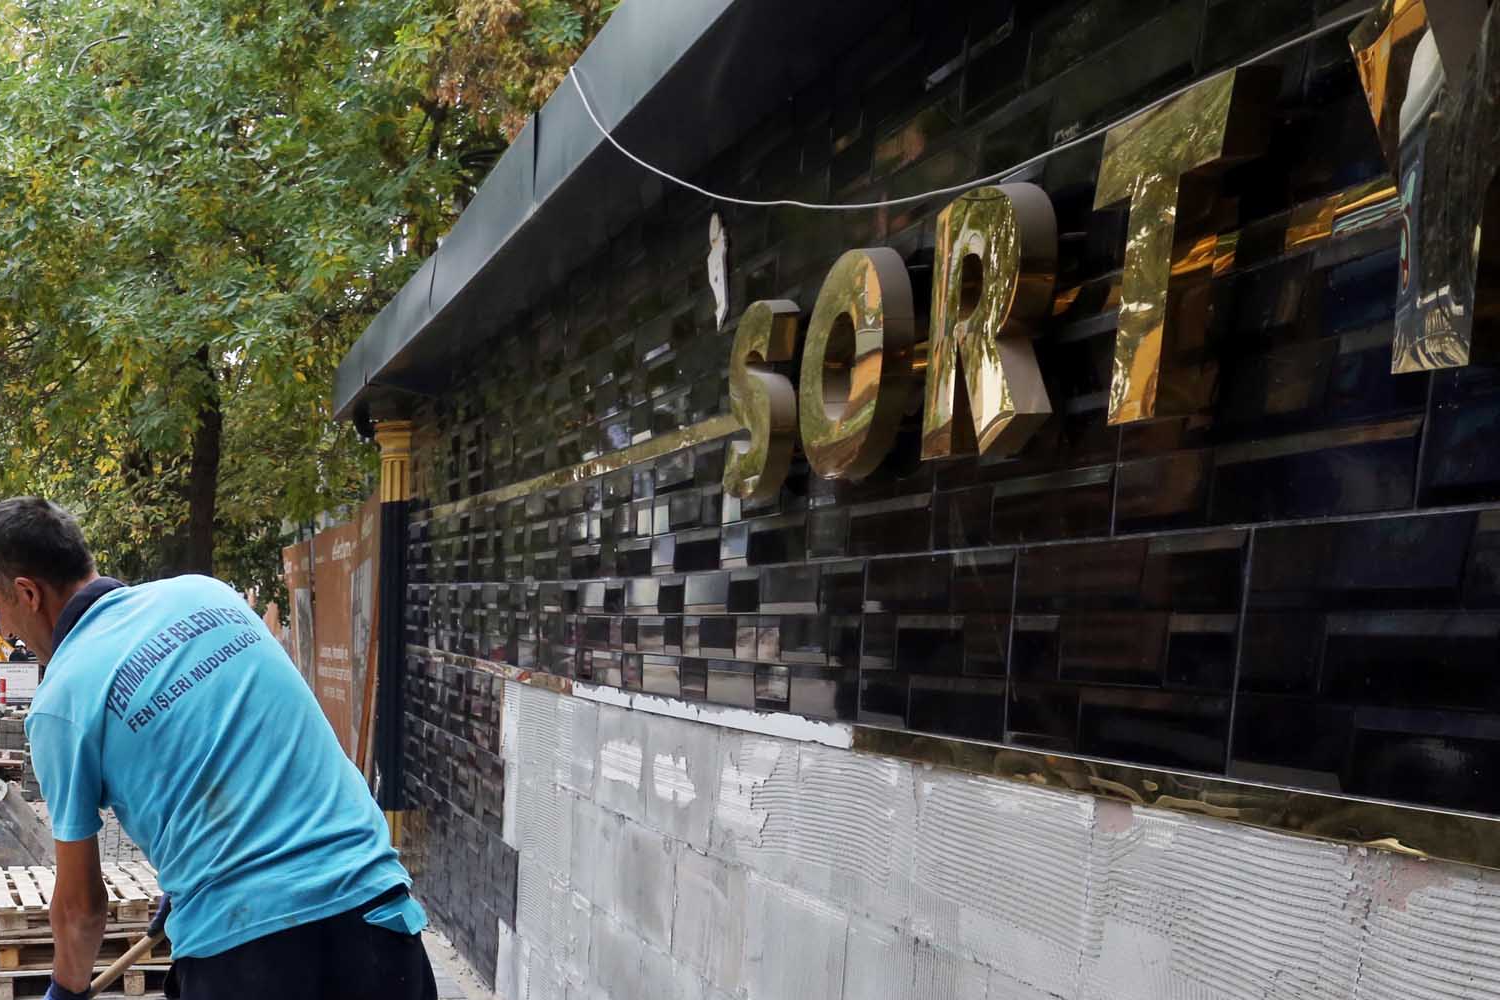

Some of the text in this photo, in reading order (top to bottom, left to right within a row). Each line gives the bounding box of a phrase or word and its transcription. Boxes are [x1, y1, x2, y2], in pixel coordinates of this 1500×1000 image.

[106, 605, 255, 721] YENİMAHALLE BELEDİYESİ
[126, 629, 262, 733] FEN İŞLERİ MÜDÜRLÜĞÜ
